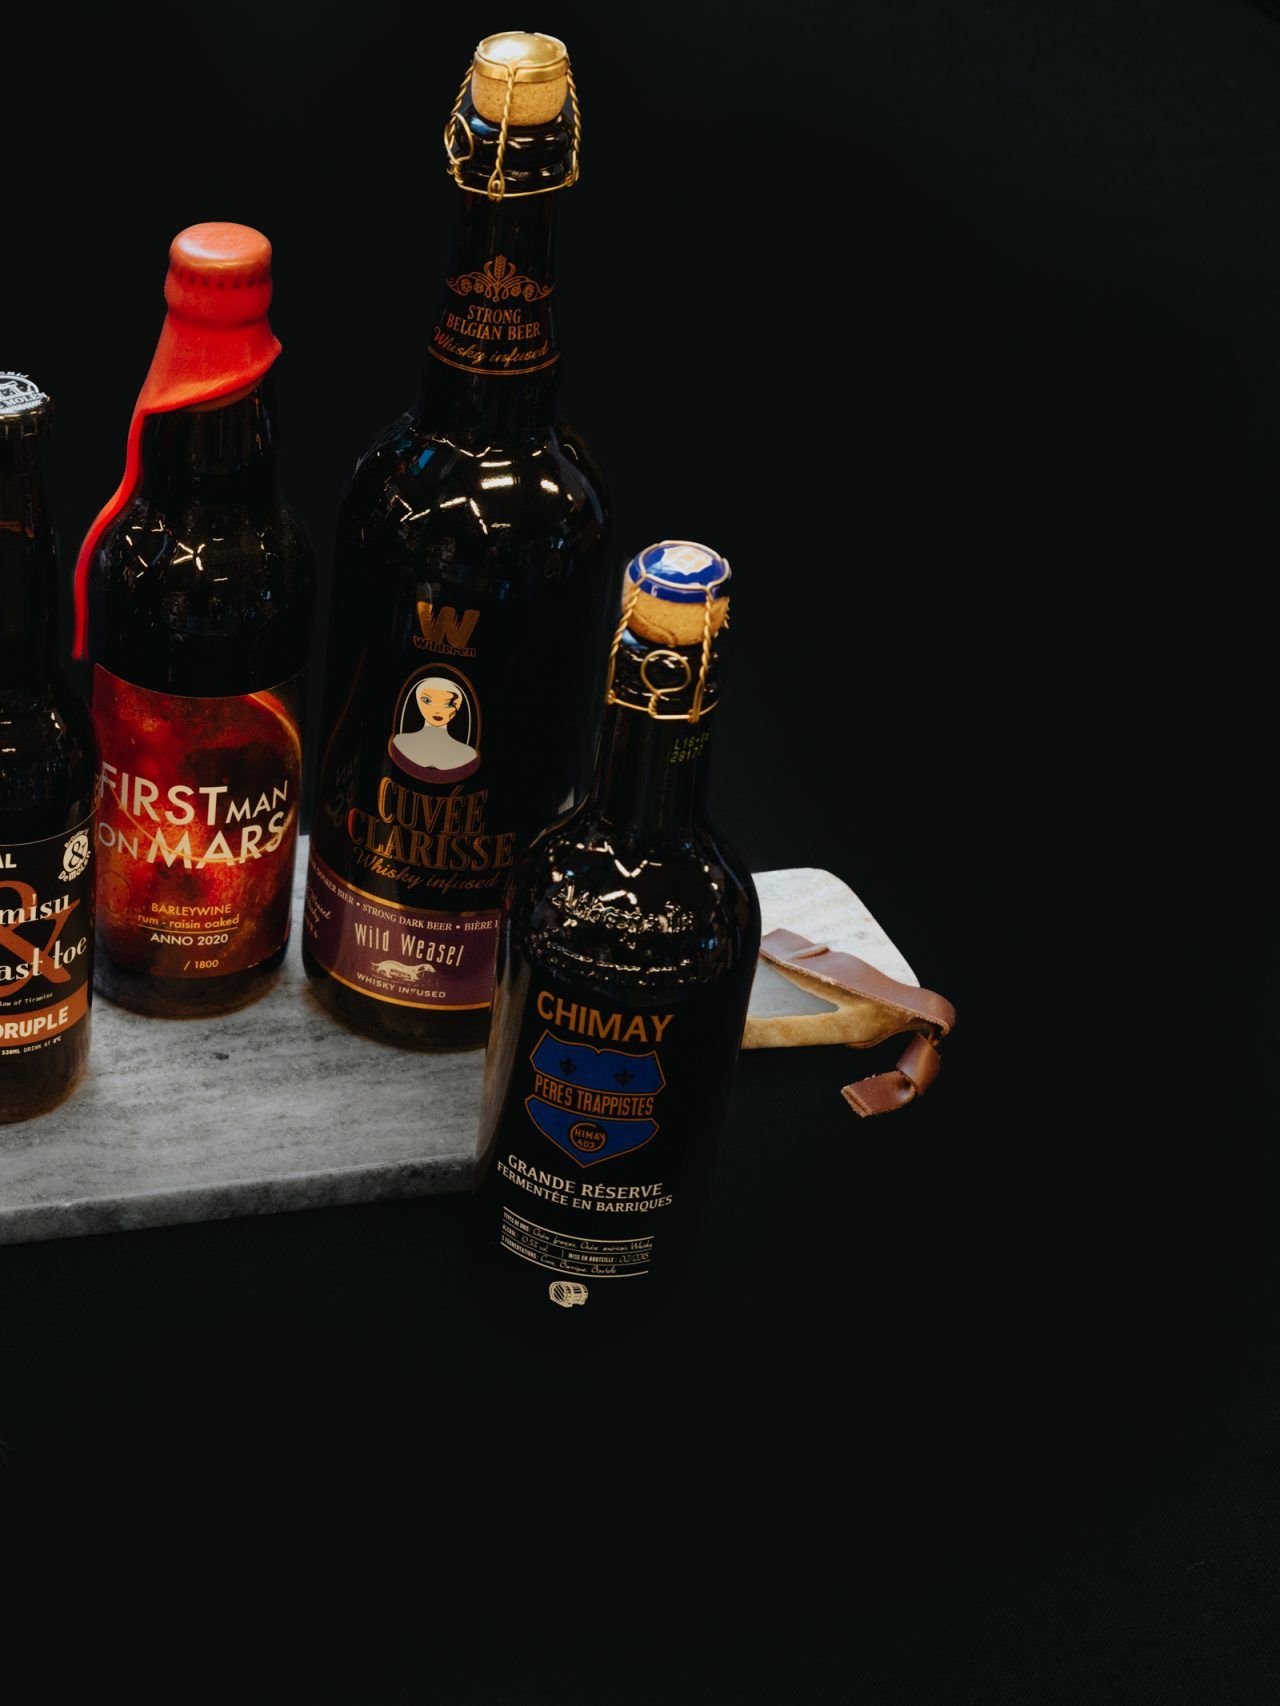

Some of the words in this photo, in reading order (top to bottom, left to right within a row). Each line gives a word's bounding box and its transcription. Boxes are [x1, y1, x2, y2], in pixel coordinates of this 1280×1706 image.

[445, 312, 503, 341] BELGIAN
[507, 321, 542, 341] BEER
[467, 305, 521, 325] STRONG
[433, 326, 487, 365] Whisky
[489, 339, 549, 368] infused
[99, 760, 228, 827] FIRST
[225, 779, 288, 825] MAN
[376, 775, 490, 837] CUVÉE
[98, 820, 140, 862] ON
[146, 810, 286, 870] MARS
[346, 806, 518, 872] CLARISSE
[352, 846, 424, 890] Whisky
[425, 872, 501, 896] infused
[137, 913, 160, 926] rum
[169, 916, 202, 930] raisin
[204, 913, 241, 929] oaked
[151, 902, 233, 917] BARLEYWINE
[363, 903, 398, 923] STRONG
[399, 916, 425, 929] DARK
[426, 920, 453, 931] BEER
[464, 920, 493, 931] BIÈRE
[52, 936, 88, 970] toe
[150, 932, 195, 947] ANNO
[197, 932, 229, 947] 2020
[354, 922, 390, 952] Wild
[400, 933, 465, 967] Weasel
[194, 958, 220, 970] 1800
[24, 992, 54, 1004] Tiramisu
[356, 972, 396, 991] WHISKY
[398, 986, 447, 999] INFUSED
[536, 990, 675, 1043] CHIMAY
[23, 1044, 42, 1053] DRINK
[533, 1073, 574, 1107] PERES
[576, 1089, 655, 1117] TRAPPISTES
[497, 1160, 570, 1206] FERMENTÉE
[572, 1198, 593, 1210] EN
[595, 1194, 673, 1213] BARRIQUES
[507, 1154, 577, 1194] GRANDE
[580, 1182, 664, 1200] RÉSERVE
